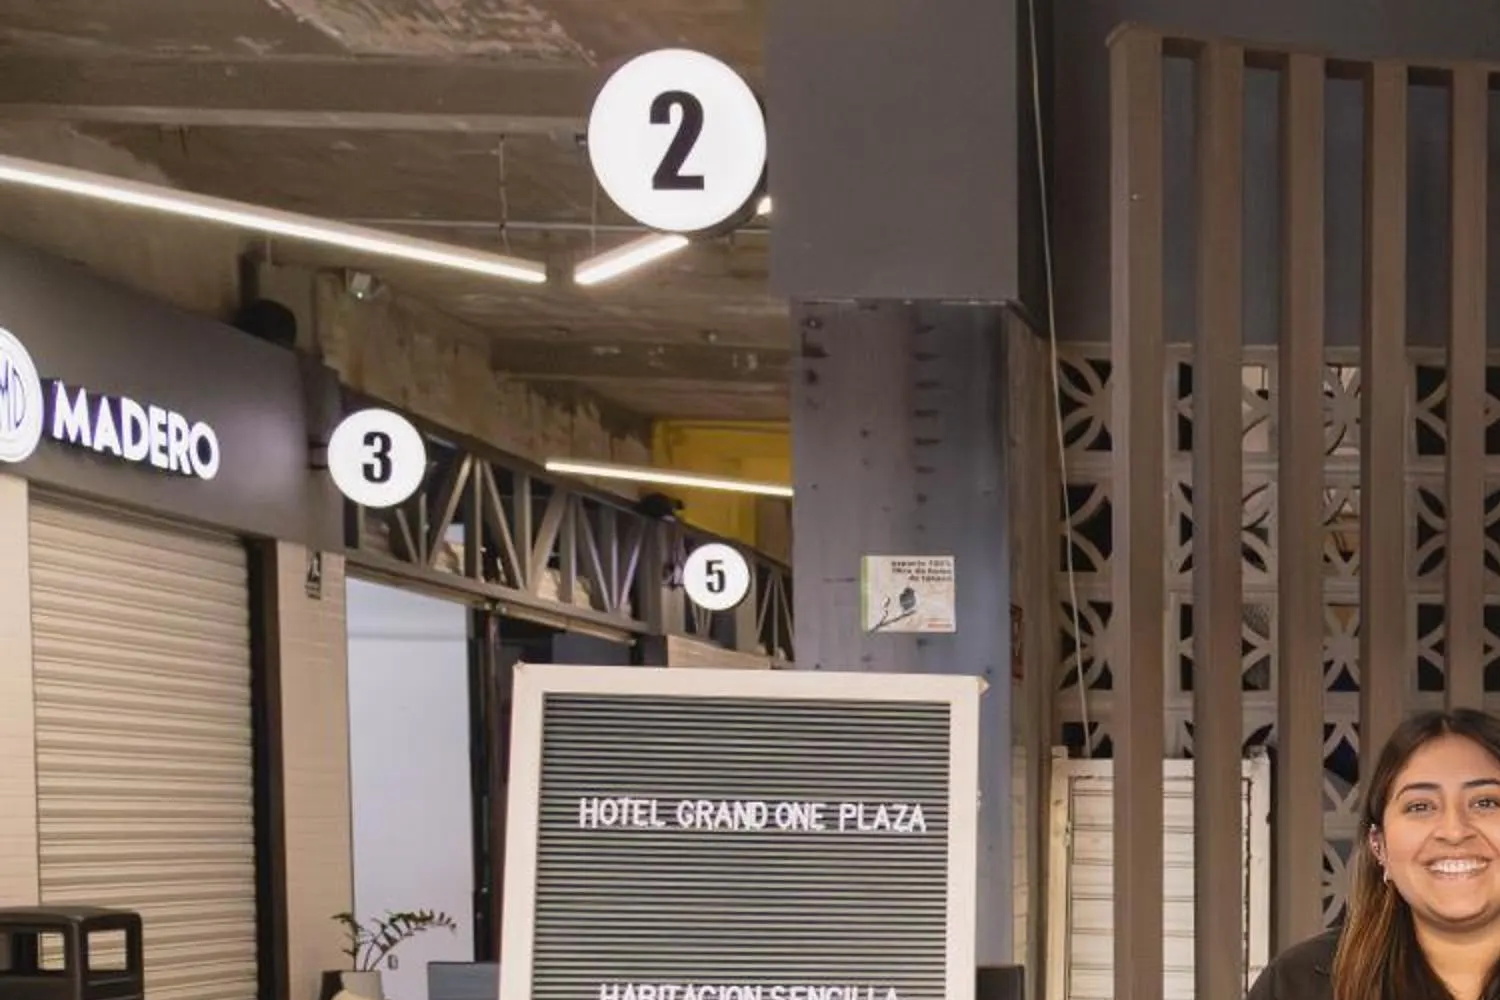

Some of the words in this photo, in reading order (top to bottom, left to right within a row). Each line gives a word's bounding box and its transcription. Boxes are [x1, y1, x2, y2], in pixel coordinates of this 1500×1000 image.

[648, 90, 706, 191] 2
[52, 380, 220, 480] MADERO
[362, 431, 393, 483] 3
[705, 559, 727, 594] 5
[579, 797, 666, 829] HOTEL
[677, 800, 768, 830] GRAND
[776, 801, 827, 831] ONE
[839, 802, 927, 832] PLAZA
